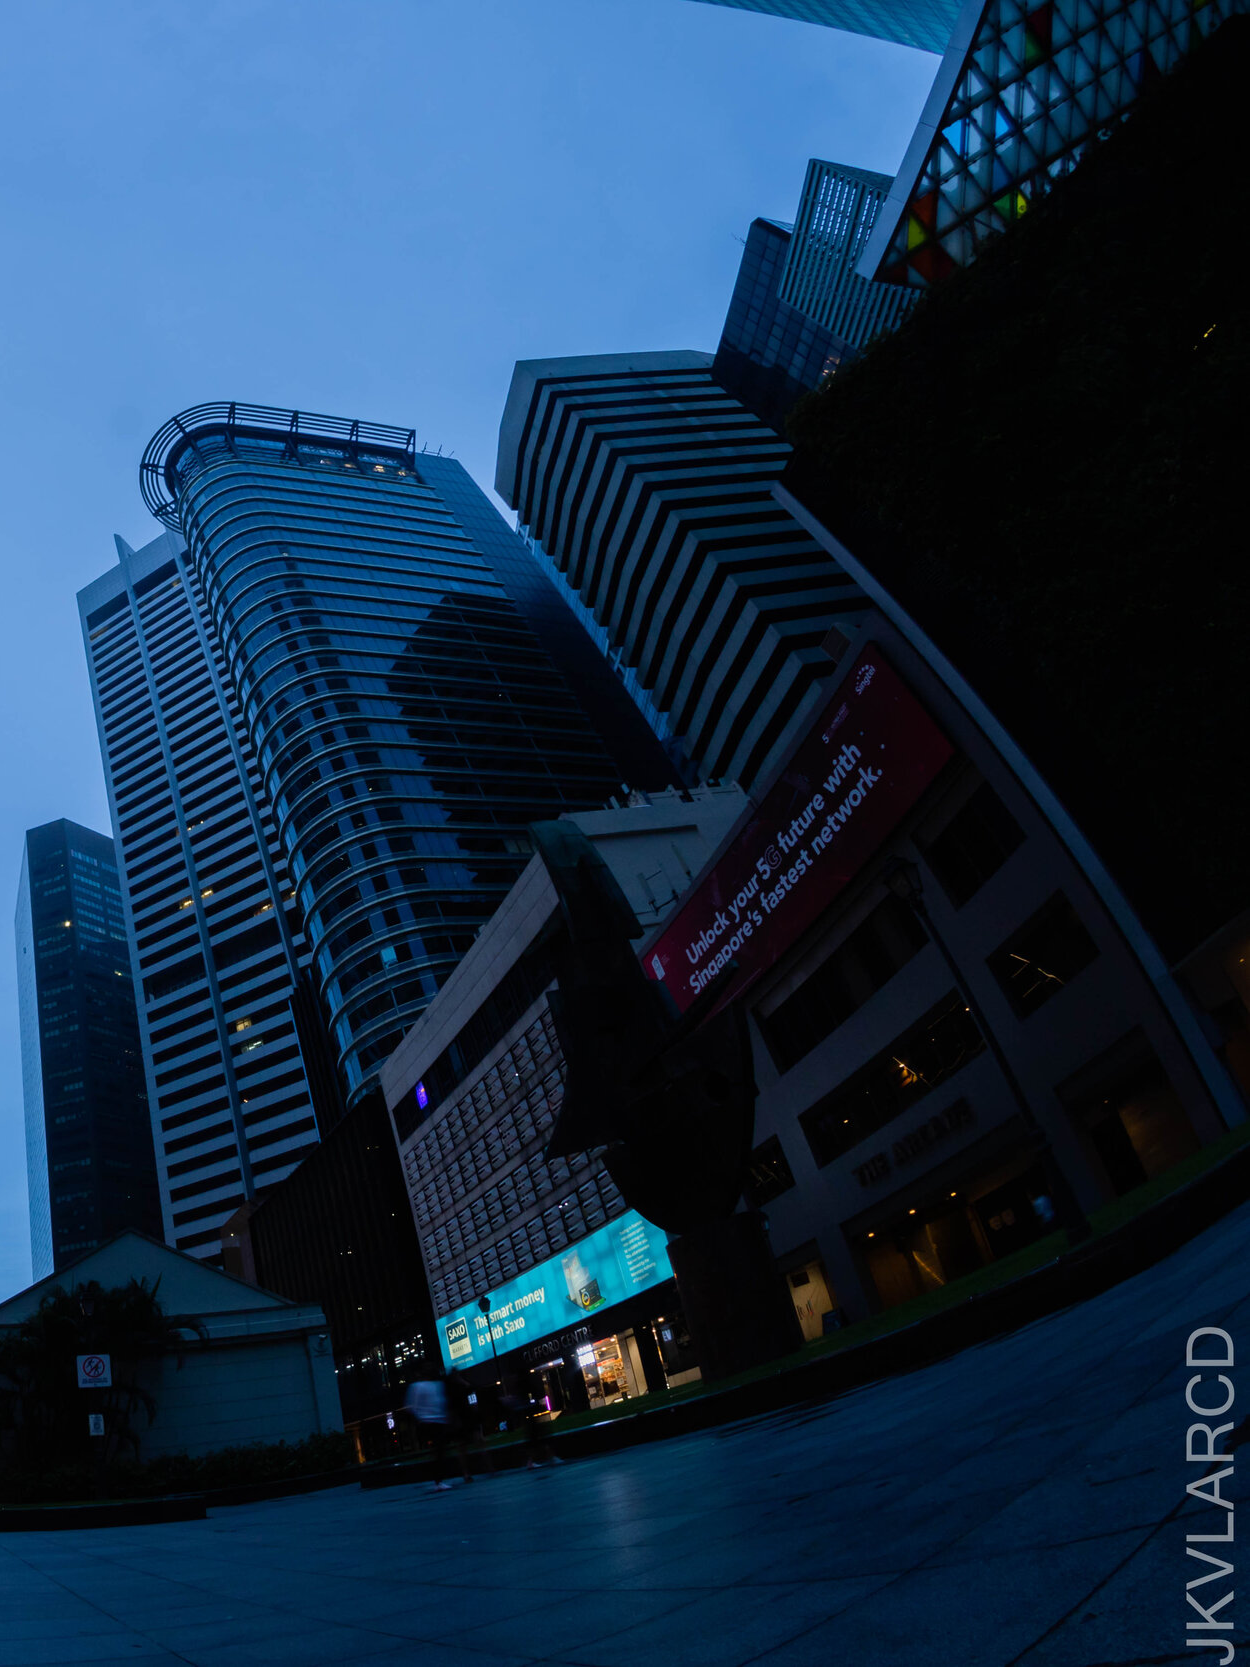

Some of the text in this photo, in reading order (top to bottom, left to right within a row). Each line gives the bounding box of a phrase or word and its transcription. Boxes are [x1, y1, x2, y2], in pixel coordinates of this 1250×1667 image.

[855, 665, 876, 696] Singtel
[686, 912, 730, 965] Unlock
[728, 873, 760, 924] your
[756, 844, 782, 880] 5G
[776, 793, 825, 854] future
[823, 744, 862, 793] with
[689, 765, 883, 995] Singapore's fastest network.
[474, 1287, 545, 1330] The smart money
[448, 1324, 465, 1341] SAXO
[477, 1317, 525, 1346] is with Saxo
